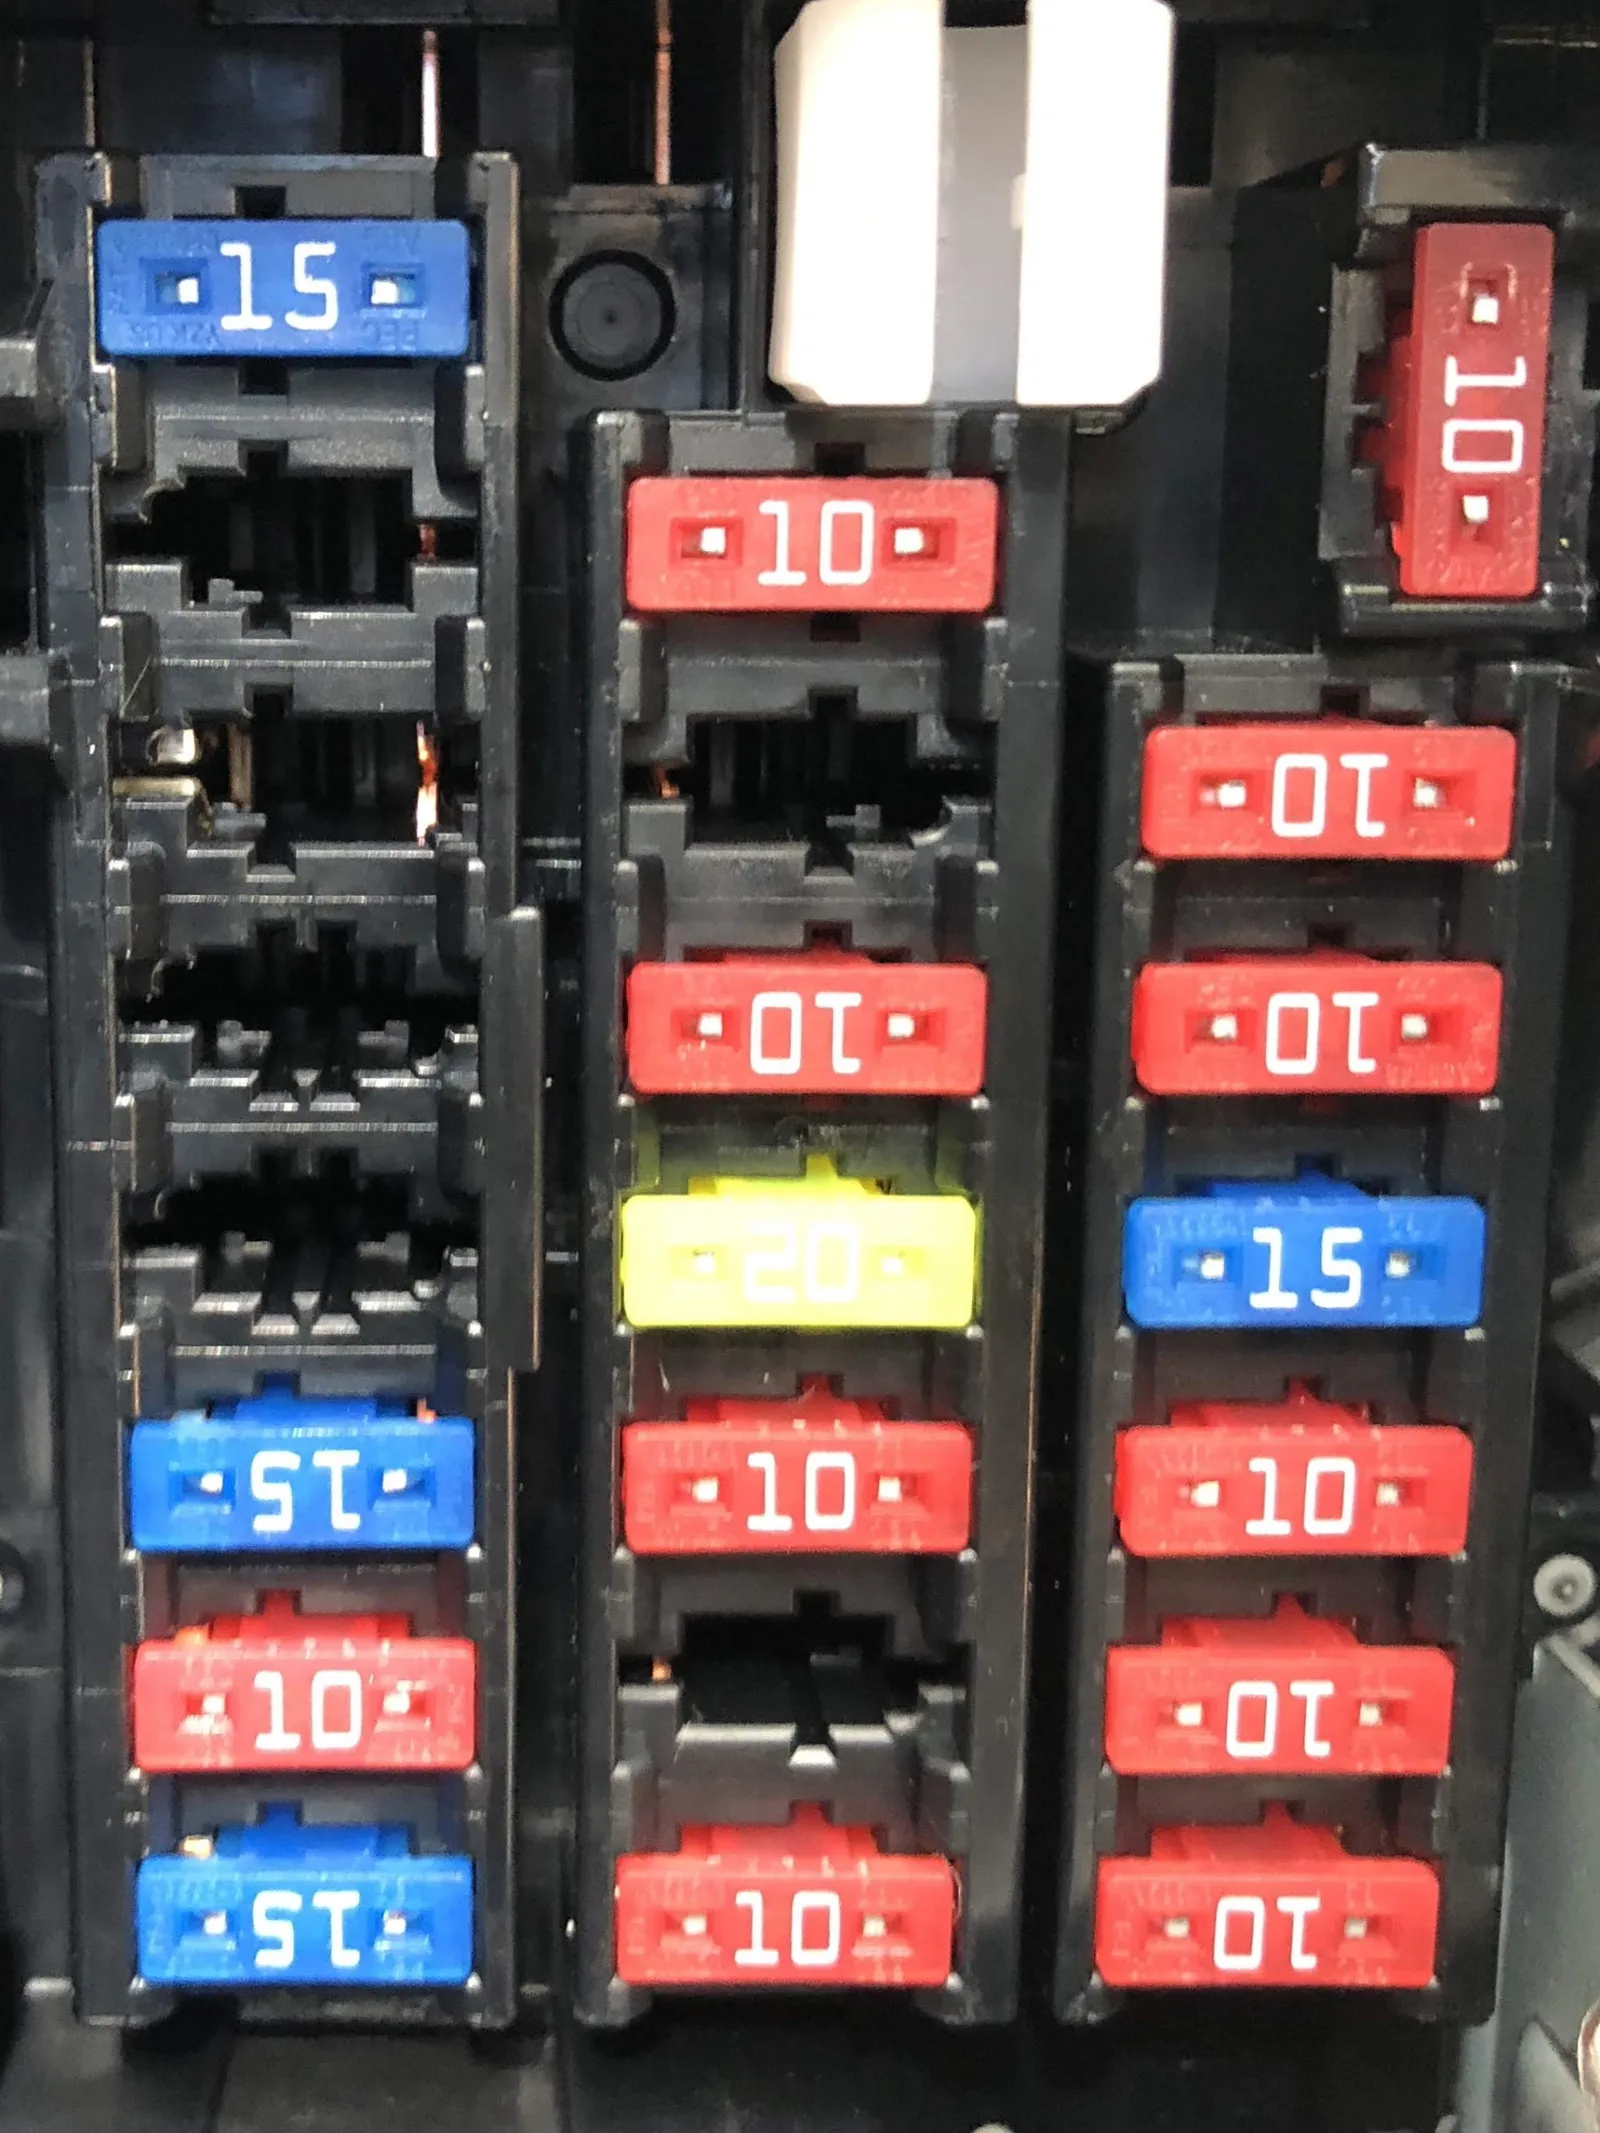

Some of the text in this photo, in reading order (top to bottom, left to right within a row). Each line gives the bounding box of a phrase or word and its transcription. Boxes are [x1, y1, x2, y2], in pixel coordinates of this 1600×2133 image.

[220, 241, 339, 331] 15
[1442, 355, 1528, 474] 10
[757, 499, 875, 587] 10
[1271, 753, 1389, 838] 10
[750, 991, 862, 1075] 10
[1265, 992, 1379, 1075] 10
[743, 1220, 859, 1304] 20
[1250, 1227, 1362, 1309] 15
[250, 1450, 361, 1533] 15
[747, 1451, 856, 1532] 10
[1245, 1457, 1356, 1536] 10
[253, 1669, 363, 1752] 10
[1226, 1681, 1334, 1758] 10
[252, 1890, 360, 1968] 15
[734, 1890, 841, 1966] 10
[1213, 1896, 1321, 1971] 10
